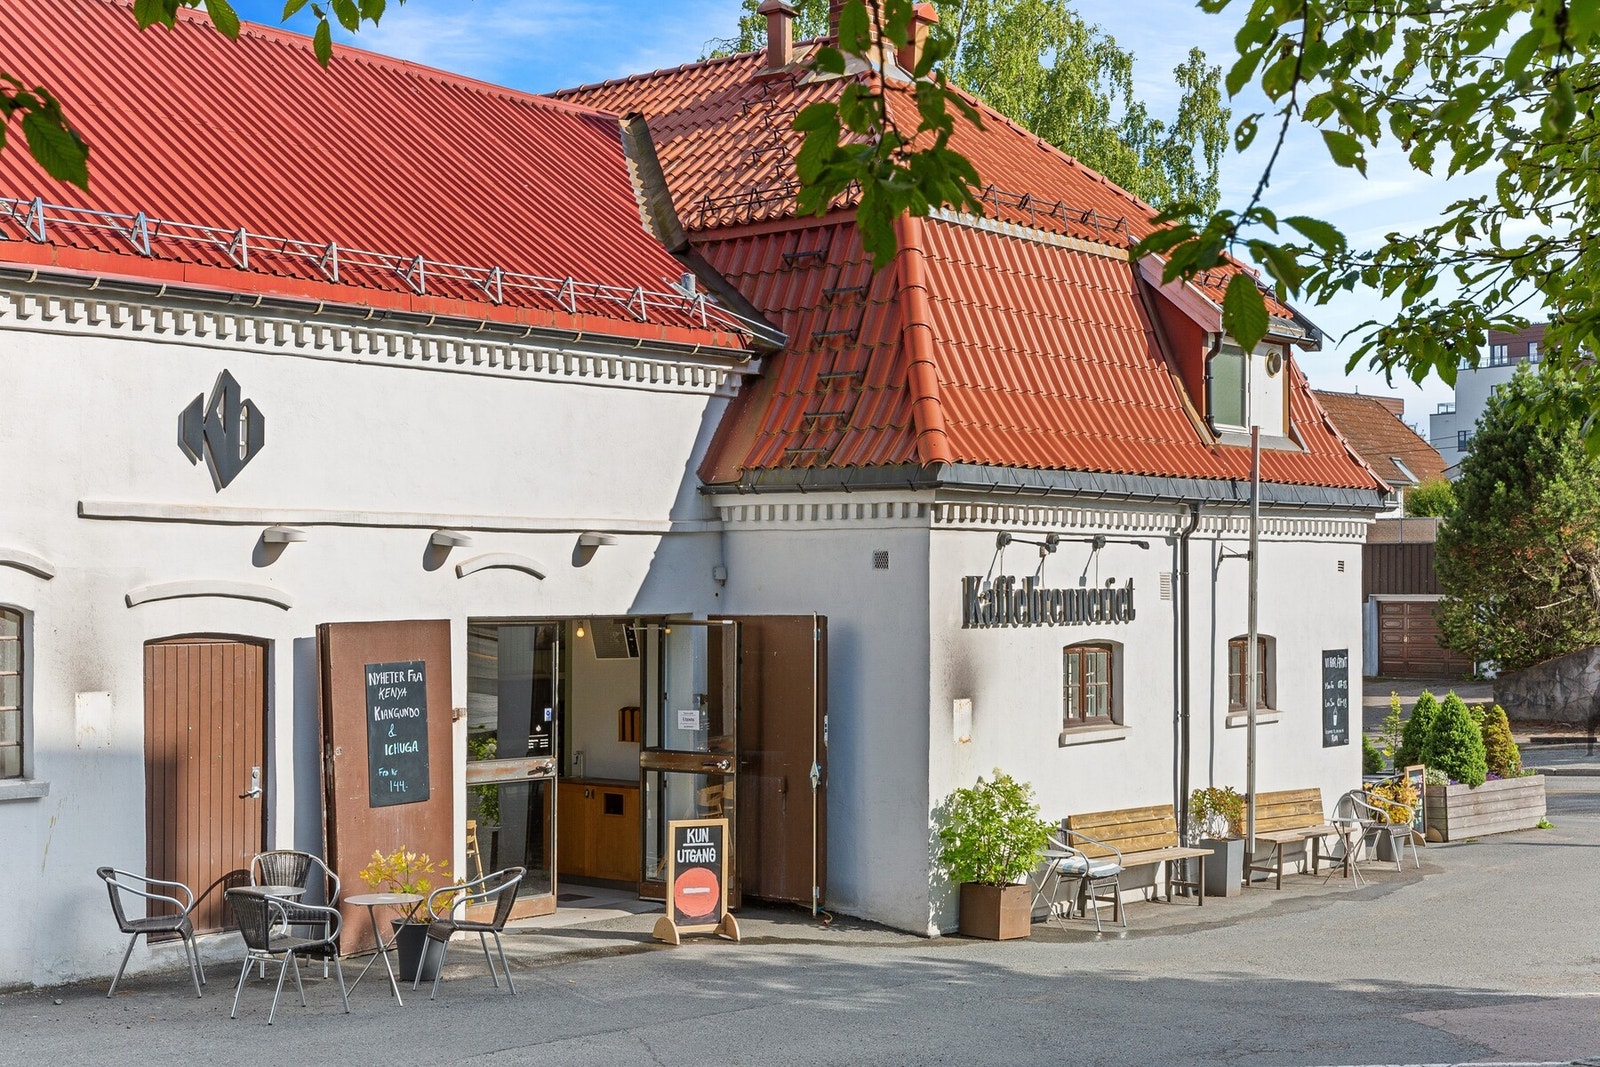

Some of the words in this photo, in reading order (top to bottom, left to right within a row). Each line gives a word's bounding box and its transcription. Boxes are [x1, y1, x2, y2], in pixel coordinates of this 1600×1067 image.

[961, 575, 1136, 629] Kaffebrenneriet
[368, 671, 405, 686] NYHETER
[378, 687, 408, 700] KENYA
[374, 706, 420, 721] KIANGUNDO
[388, 723, 397, 738] &
[384, 740, 419, 756] ICHUGA
[686, 828, 709, 843] KUN
[677, 847, 716, 863] UTGANG
